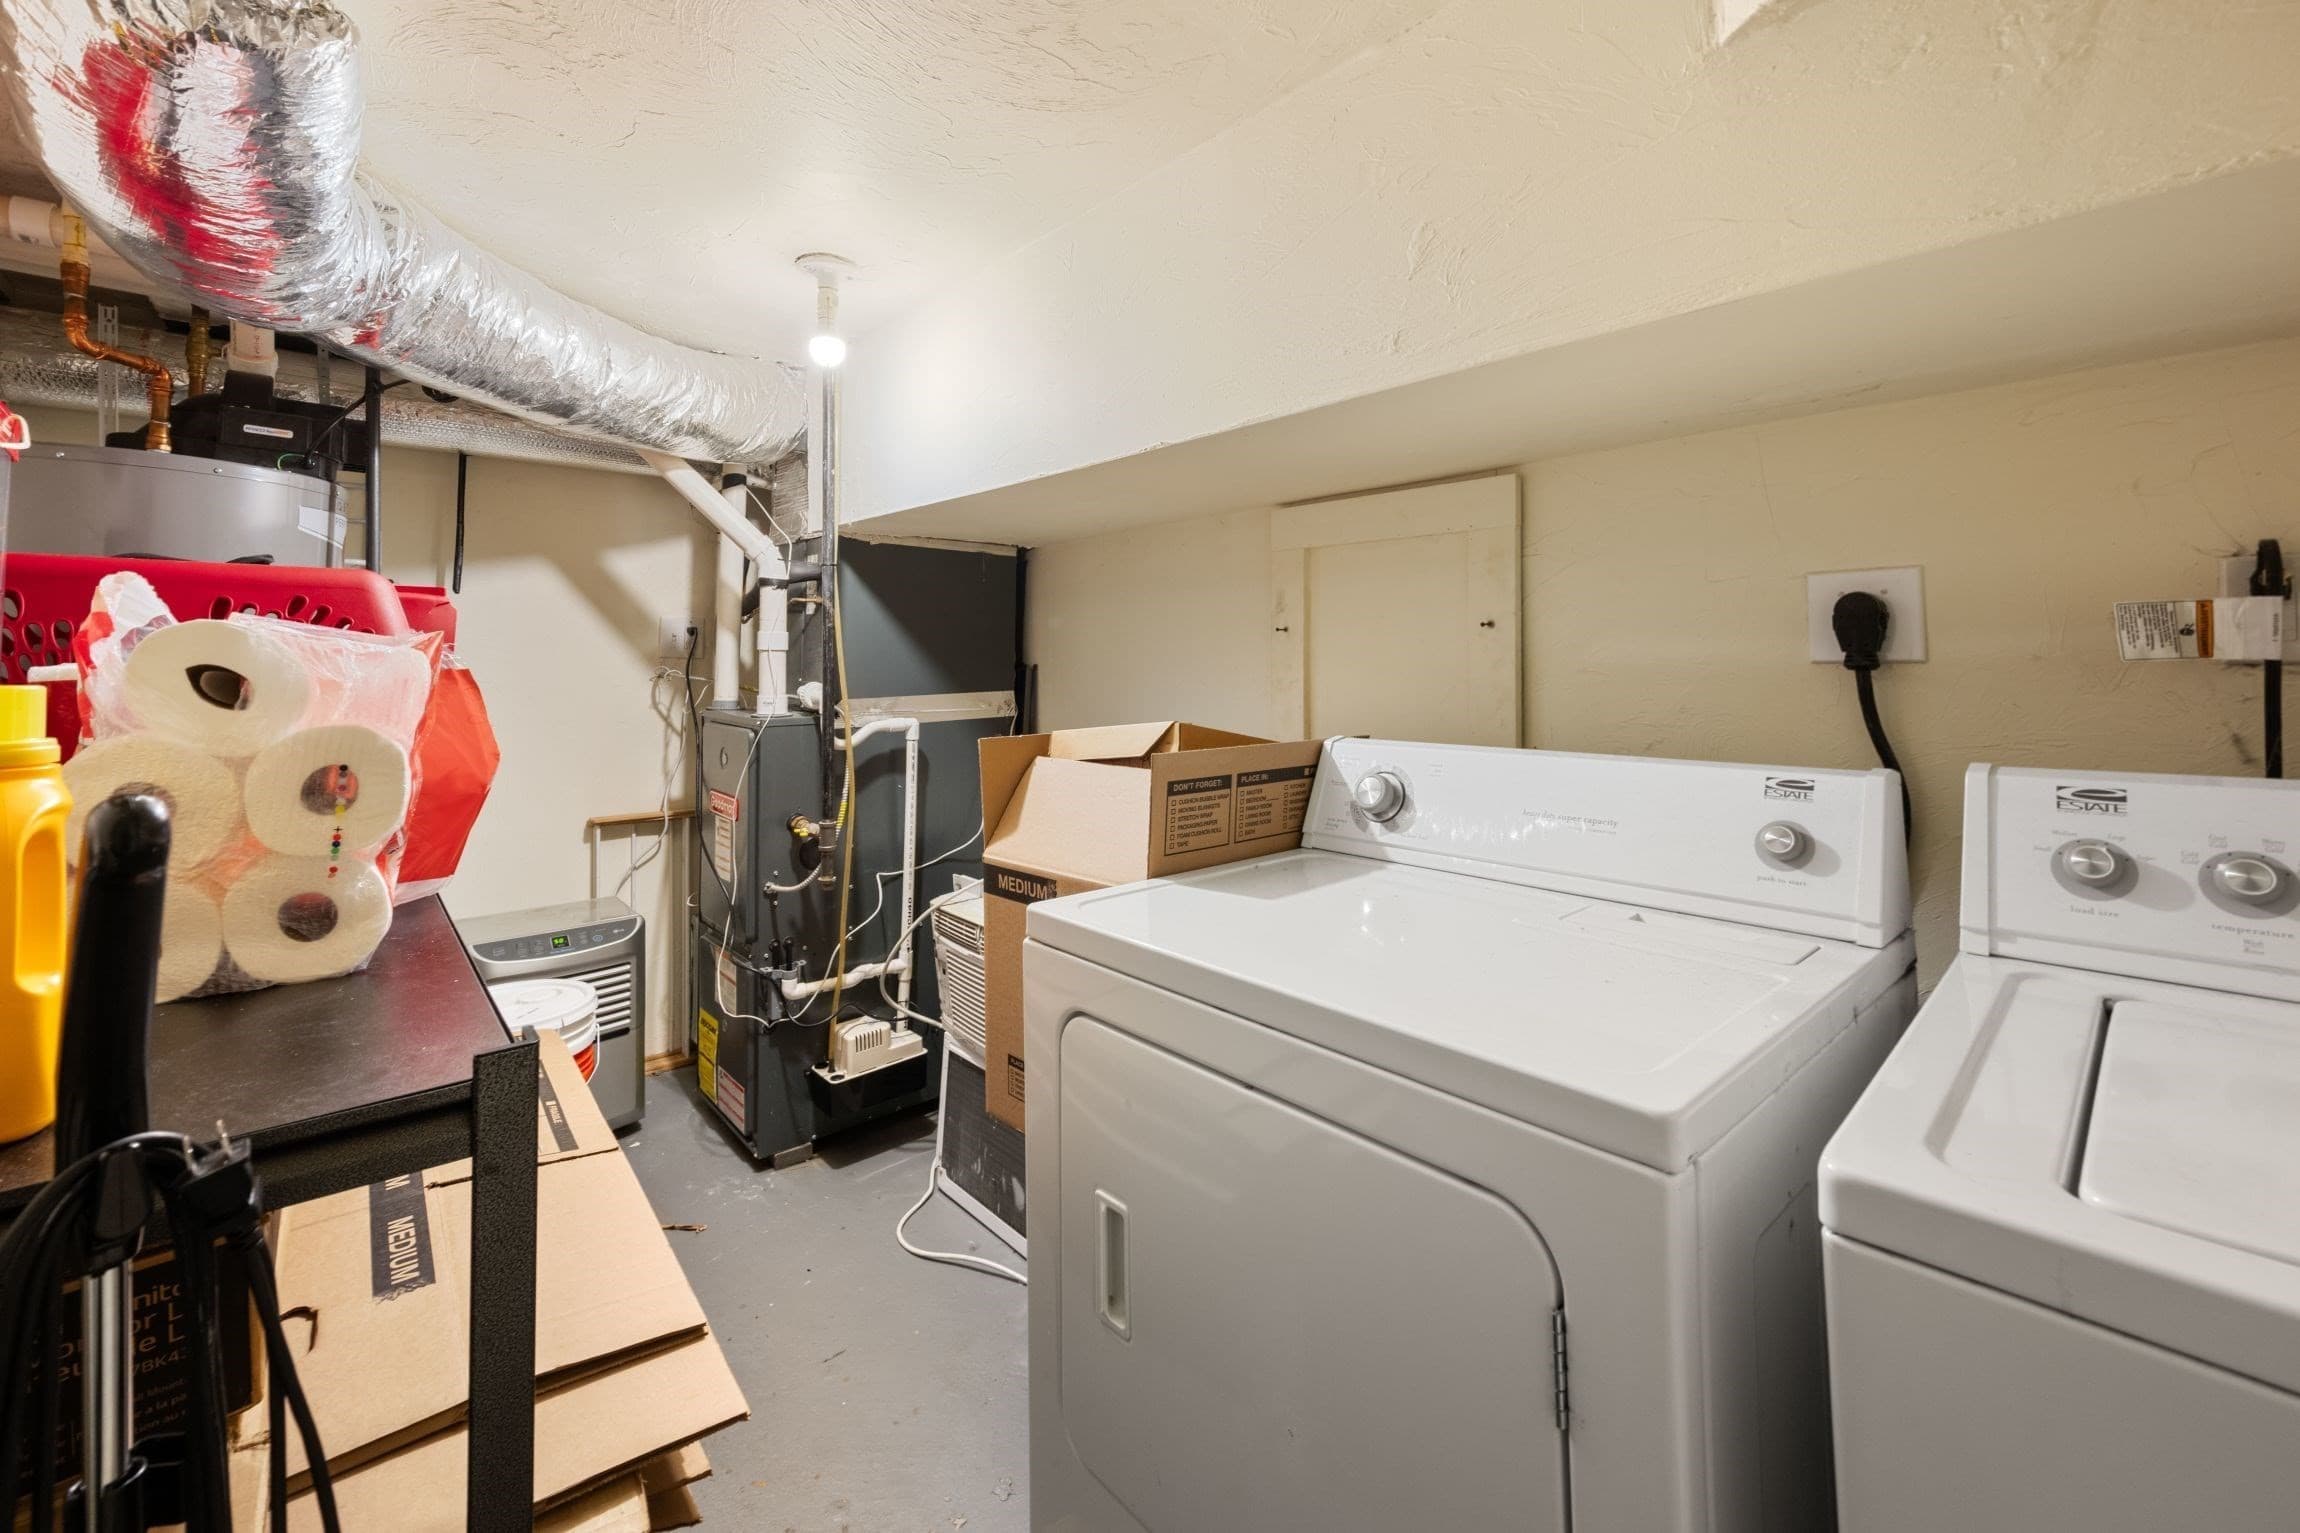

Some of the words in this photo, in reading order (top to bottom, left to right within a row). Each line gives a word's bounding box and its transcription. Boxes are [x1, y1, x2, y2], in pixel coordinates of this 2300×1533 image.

[1173, 782, 1194, 792] DON'T
[1195, 779, 1222, 789] FORGET:
[1764, 788, 1814, 801] ESTATE
[2056, 800, 2128, 814] ESTATE
[1558, 815, 1582, 824] super
[1583, 816, 1618, 829] capacity
[998, 873, 1048, 900] MEDIUM
[2070, 905, 2095, 915] load
[2210, 923, 2294, 938] temperature
[387, 1214, 420, 1285] MEDIUM
